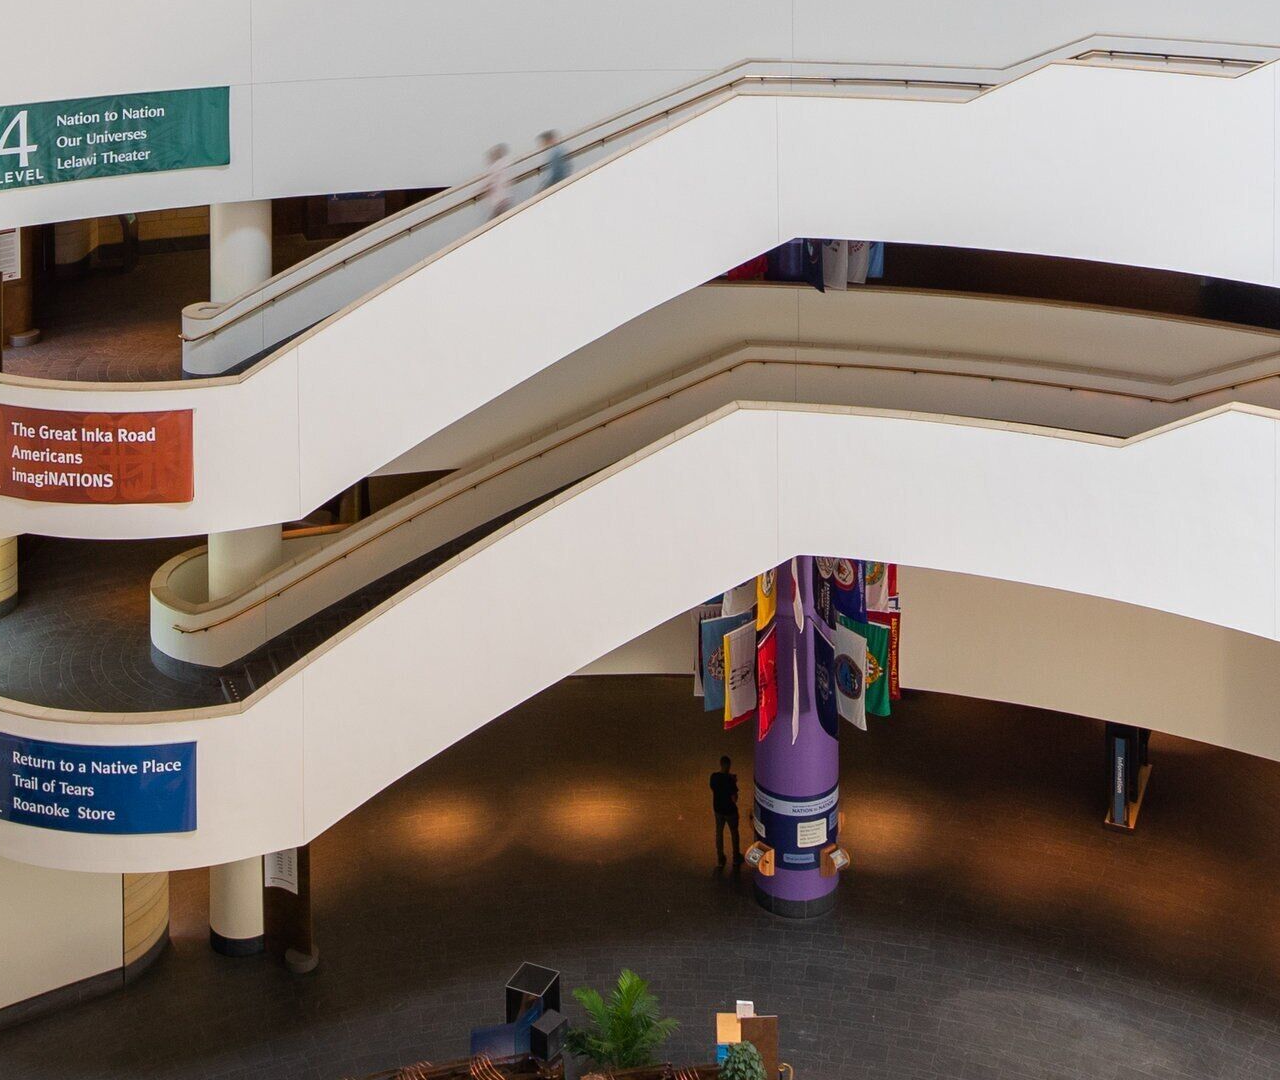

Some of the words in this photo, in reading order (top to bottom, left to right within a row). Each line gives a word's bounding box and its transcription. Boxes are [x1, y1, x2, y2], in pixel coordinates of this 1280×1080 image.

[56, 112, 100, 127] Nation
[104, 110, 118, 121] to
[122, 105, 165, 119] Nation
[56, 135, 82, 148] Our
[86, 130, 147, 145] Universes
[57, 154, 97, 170] Lelawi
[101, 149, 151, 164] Theater
[11, 422, 36, 438] The
[39, 425, 78, 442] Great
[81, 427, 113, 443] Inka
[117, 427, 156, 443] Road
[11, 445, 83, 465] Americans
[12, 467, 114, 488] imagiNATIONS
[12, 751, 55, 771] Return
[60, 759, 74, 772] to
[78, 763, 86, 773] a
[91, 760, 138, 774] Native
[142, 759, 182, 774] Place
[12, 774, 38, 791] Trail
[42, 779, 56, 793] of
[59, 781, 95, 797] Tears
[1115, 756, 1124, 794] Information
[13, 797, 70, 818] Roanoke
[77, 806, 116, 821] Store
